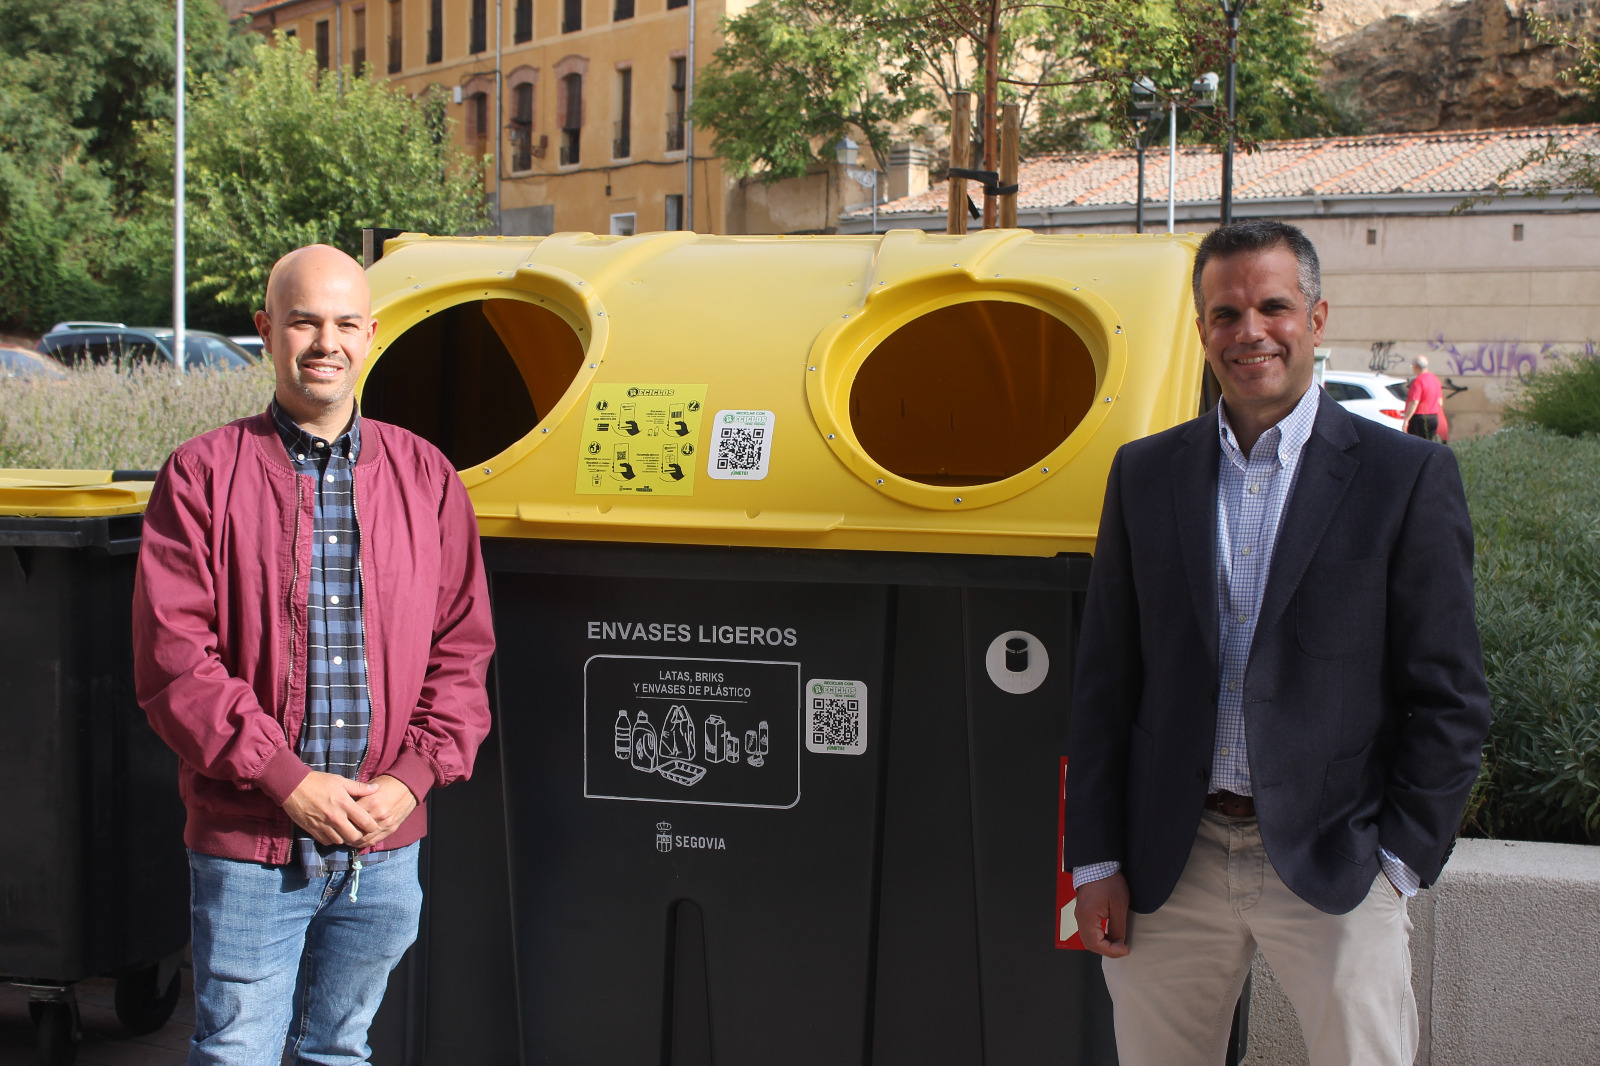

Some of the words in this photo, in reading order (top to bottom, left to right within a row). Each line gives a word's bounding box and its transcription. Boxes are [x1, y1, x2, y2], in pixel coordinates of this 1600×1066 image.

[627, 387, 675, 398] RECICLOS
[723, 414, 768, 424] RECICLOS
[587, 621, 691, 643] ENVASES
[698, 624, 798, 647] LIGEROS
[659, 670, 693, 683] LATAS,
[695, 671, 724, 683] BRIKS
[633, 683, 640, 693] Y
[642, 683, 686, 695] ENVASES
[688, 685, 702, 695] DE
[704, 684, 751, 698] PLÁSTICO
[812, 684, 857, 695] RECICLOS
[675, 835, 726, 850] SEGOVIA
